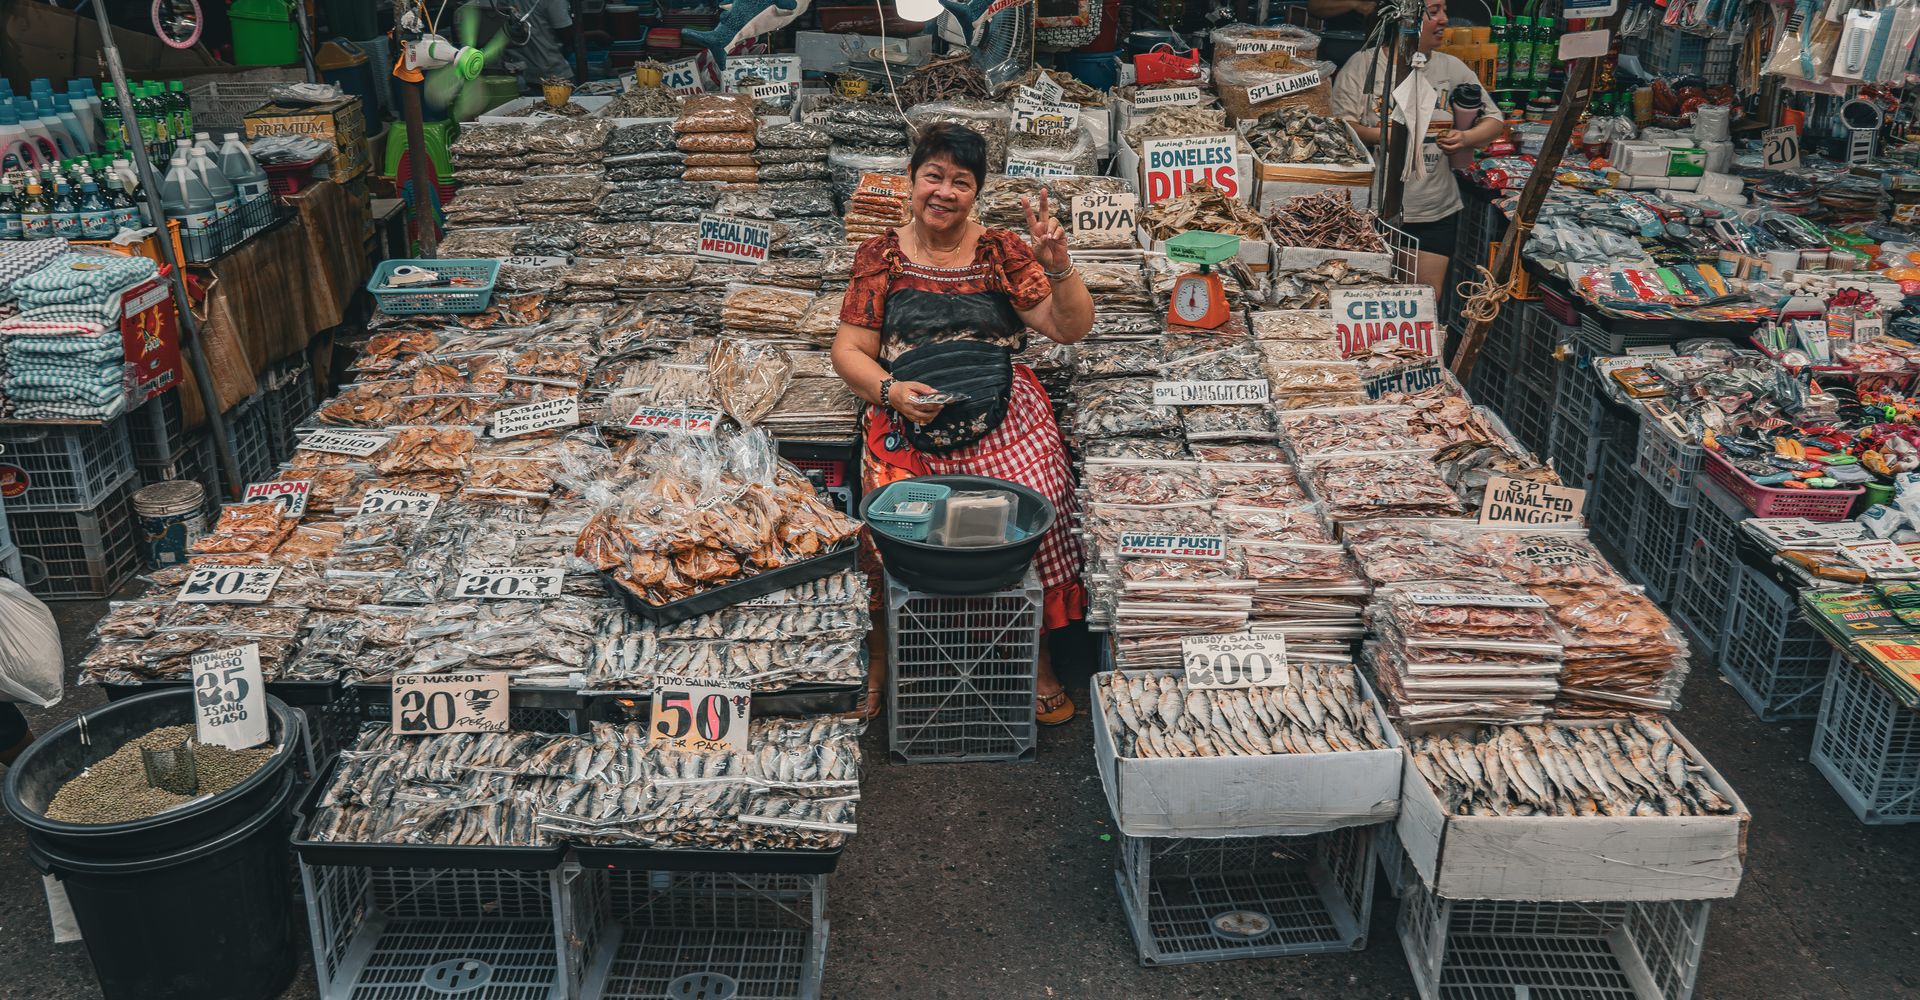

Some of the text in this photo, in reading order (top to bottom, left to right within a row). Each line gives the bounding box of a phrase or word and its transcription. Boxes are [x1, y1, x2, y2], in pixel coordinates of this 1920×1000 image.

[1236, 42, 1267, 52] HIPON
[754, 85, 787, 97] HIPON
[1276, 73, 1319, 94] ALAMANG
[1136, 91, 1198, 104] BONELESS DILIS
[1185, 138, 1207, 146] Dried
[1209, 137, 1228, 145] Fish
[1150, 146, 1233, 169] BONELESS
[700, 221, 769, 249] SPECIAL DILIS
[701, 239, 765, 260] MEDIUM
[1346, 300, 1418, 320] CEBU
[1365, 367, 1441, 400] WEET PUSIT
[500, 397, 575, 418] LABAHITA
[532, 407, 573, 420] GULAY
[532, 417, 566, 428] GATA
[308, 434, 377, 449] BISUGO
[247, 482, 309, 497] HIPON
[374, 488, 429, 498] AYUNGIN
[1508, 481, 1553, 497] SPL
[360, 497, 409, 515] 20
[1493, 489, 1574, 513] UNSALTED
[1488, 504, 1574, 524] DANGGIT
[1120, 536, 1223, 550] SWEET PUSIT
[1171, 548, 1221, 556] CEBU
[185, 570, 245, 596] 20
[463, 576, 520, 596] 20
[1843, 612, 1868, 620] Glue
[1228, 633, 1281, 643] SALINAS
[1207, 642, 1266, 652] ROXAS
[204, 657, 242, 671] LABO
[1188, 652, 1272, 686] 200
[195, 666, 250, 707] 25
[203, 702, 244, 717] ISANG
[400, 690, 456, 731] 20
[656, 691, 731, 741] 50
[208, 710, 248, 727] BASO
